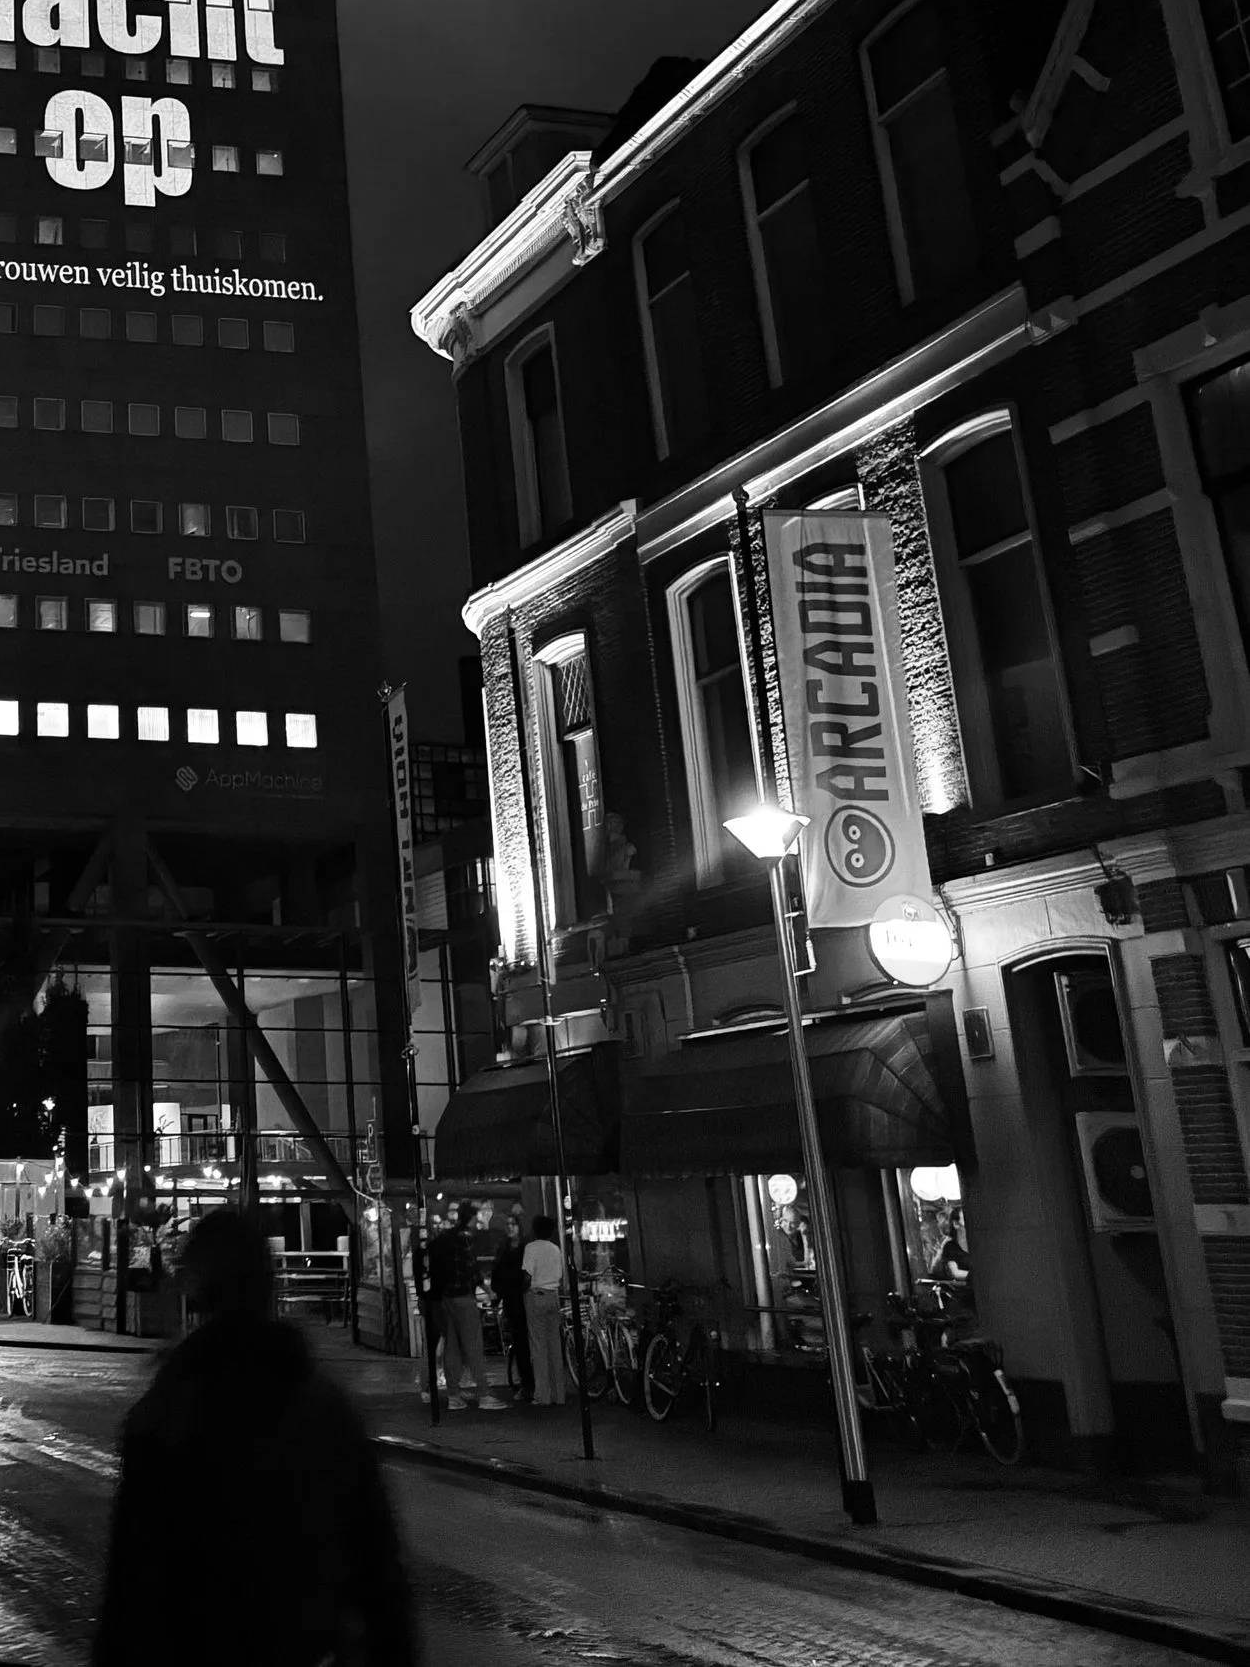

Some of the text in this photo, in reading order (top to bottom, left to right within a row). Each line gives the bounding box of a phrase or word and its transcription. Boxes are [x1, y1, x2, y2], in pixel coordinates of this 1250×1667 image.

[42, 88, 197, 208] op
[96, 261, 166, 297] veilig
[170, 264, 325, 302] thuiskomen.
[167, 556, 243, 584] FBTO
[792, 542, 889, 801] ARCADIA
